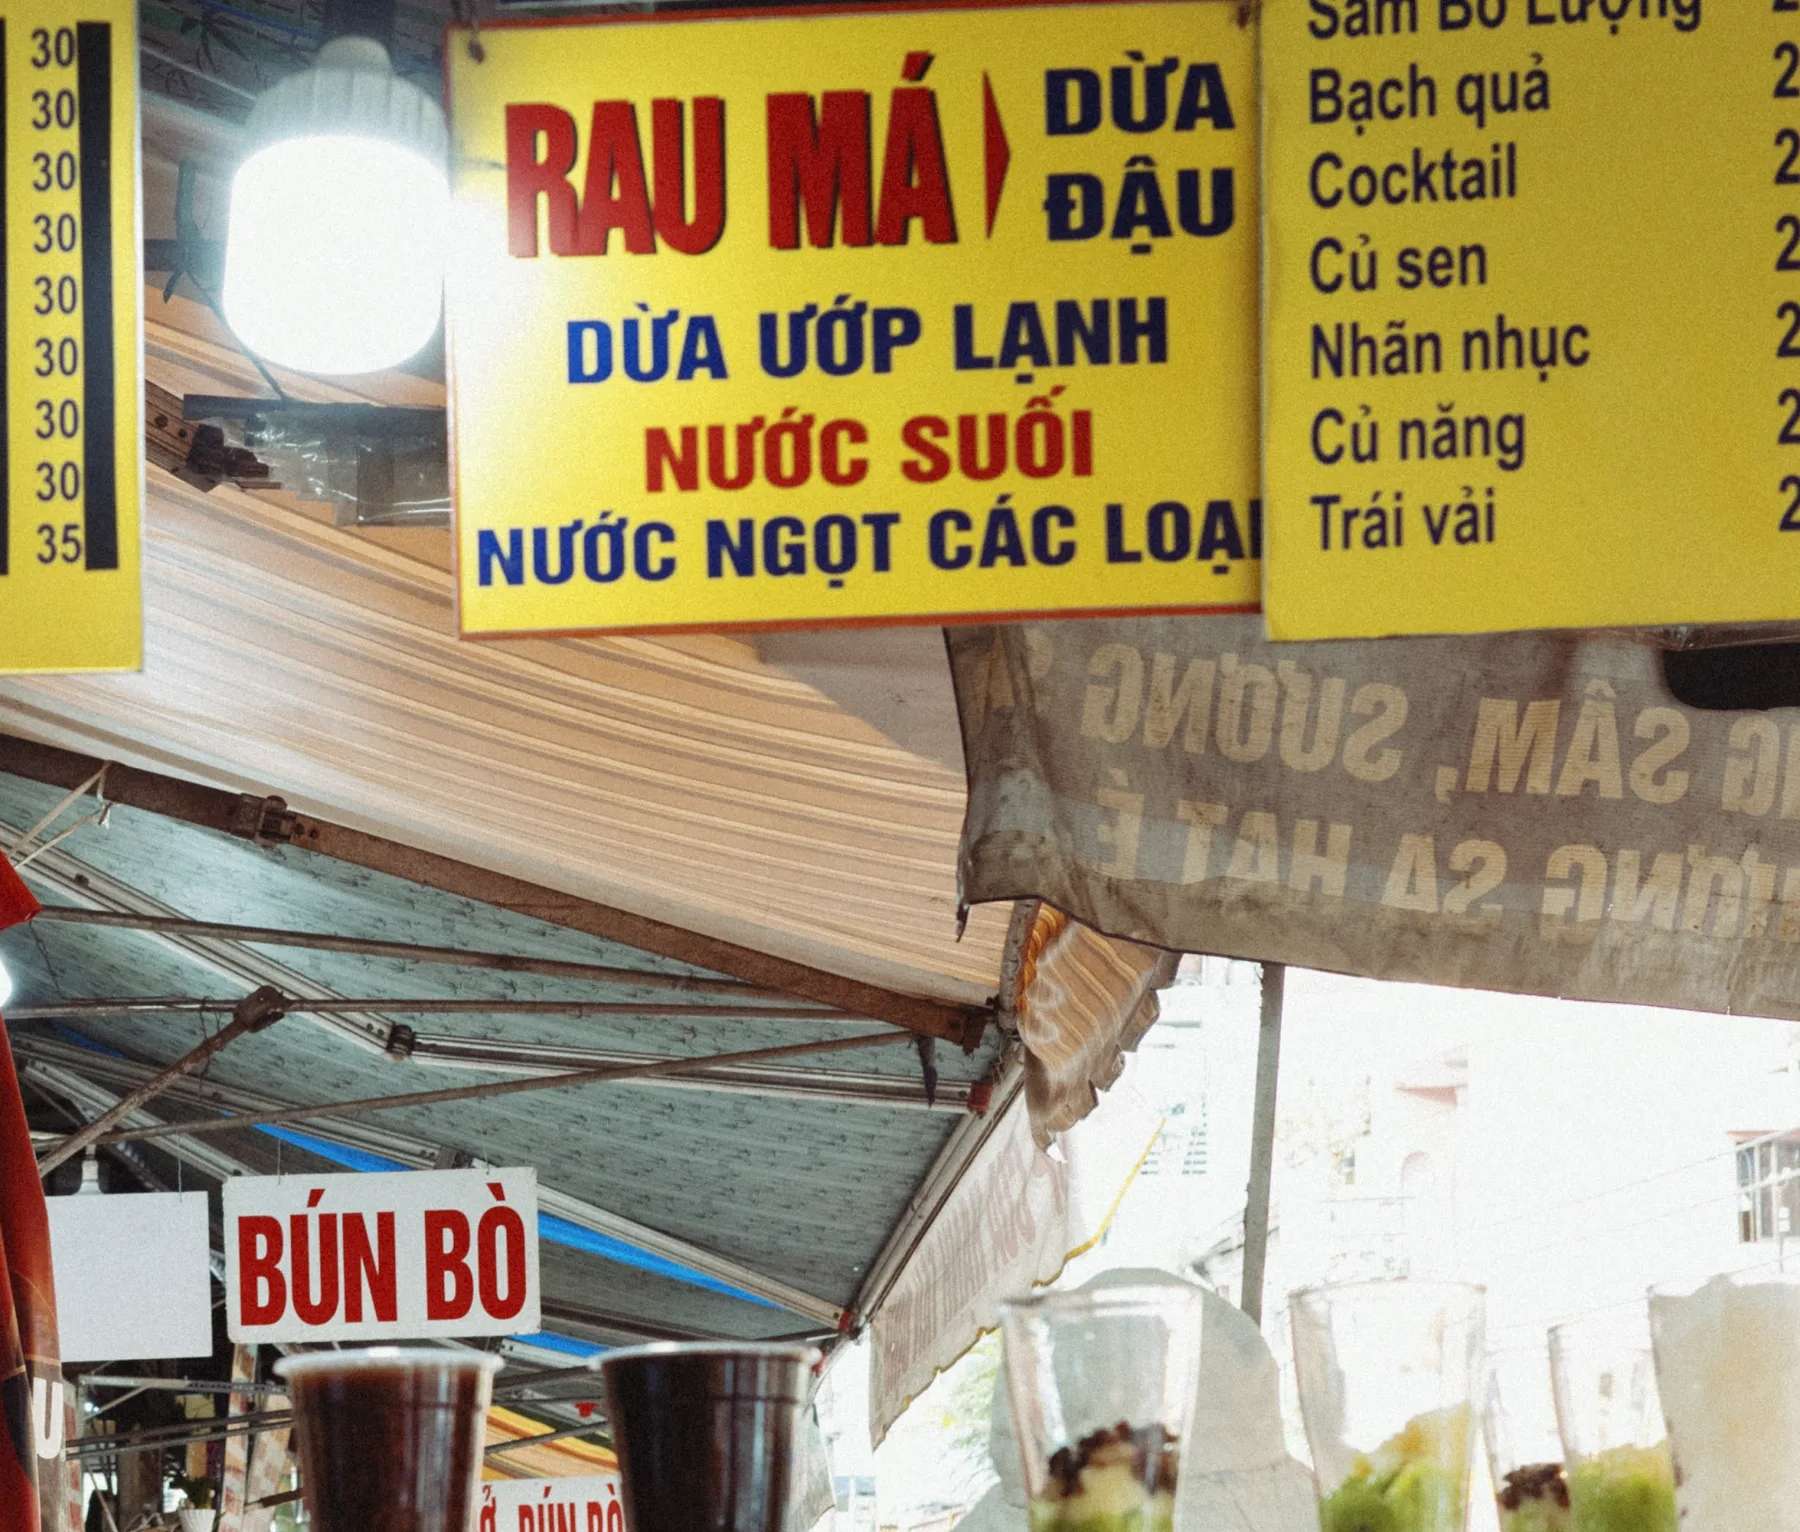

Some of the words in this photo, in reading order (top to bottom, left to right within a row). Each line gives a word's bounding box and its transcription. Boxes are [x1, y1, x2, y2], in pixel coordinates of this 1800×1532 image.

[32, 27, 76, 69] 30
[1310, 63, 1436, 136] Bạch
[1456, 53, 1549, 129] quả
[506, 96, 727, 257] RAU
[767, 51, 959, 250] MÁ
[1045, 51, 1236, 136] DỪA
[1310, 142, 1516, 208] Cocktail
[1043, 155, 1235, 255] ĐẬU
[1310, 234, 1377, 294] Củ
[1398, 244, 1486, 289] sen
[568, 303, 728, 383] DỪA
[760, 294, 921, 378] ƯỚP
[954, 296, 1168, 384] LẠNH
[1312, 321, 1441, 378] Nhãn
[1463, 314, 1589, 382] nhục
[646, 407, 868, 492] NƯỚC
[902, 385, 1093, 484] SUỐI
[1311, 405, 1378, 465] Củ
[1400, 403, 1524, 471] năng
[37, 524, 83, 564] 35
[479, 511, 676, 586] NƯỚC
[707, 513, 900, 588] NGỌT
[929, 494, 1076, 570] CÁC
[1310, 491, 1402, 550] Trái
[1423, 486, 1494, 545] vải
[238, 1188, 397, 1326] BÚN
[425, 1182, 526, 1321] BÒ
